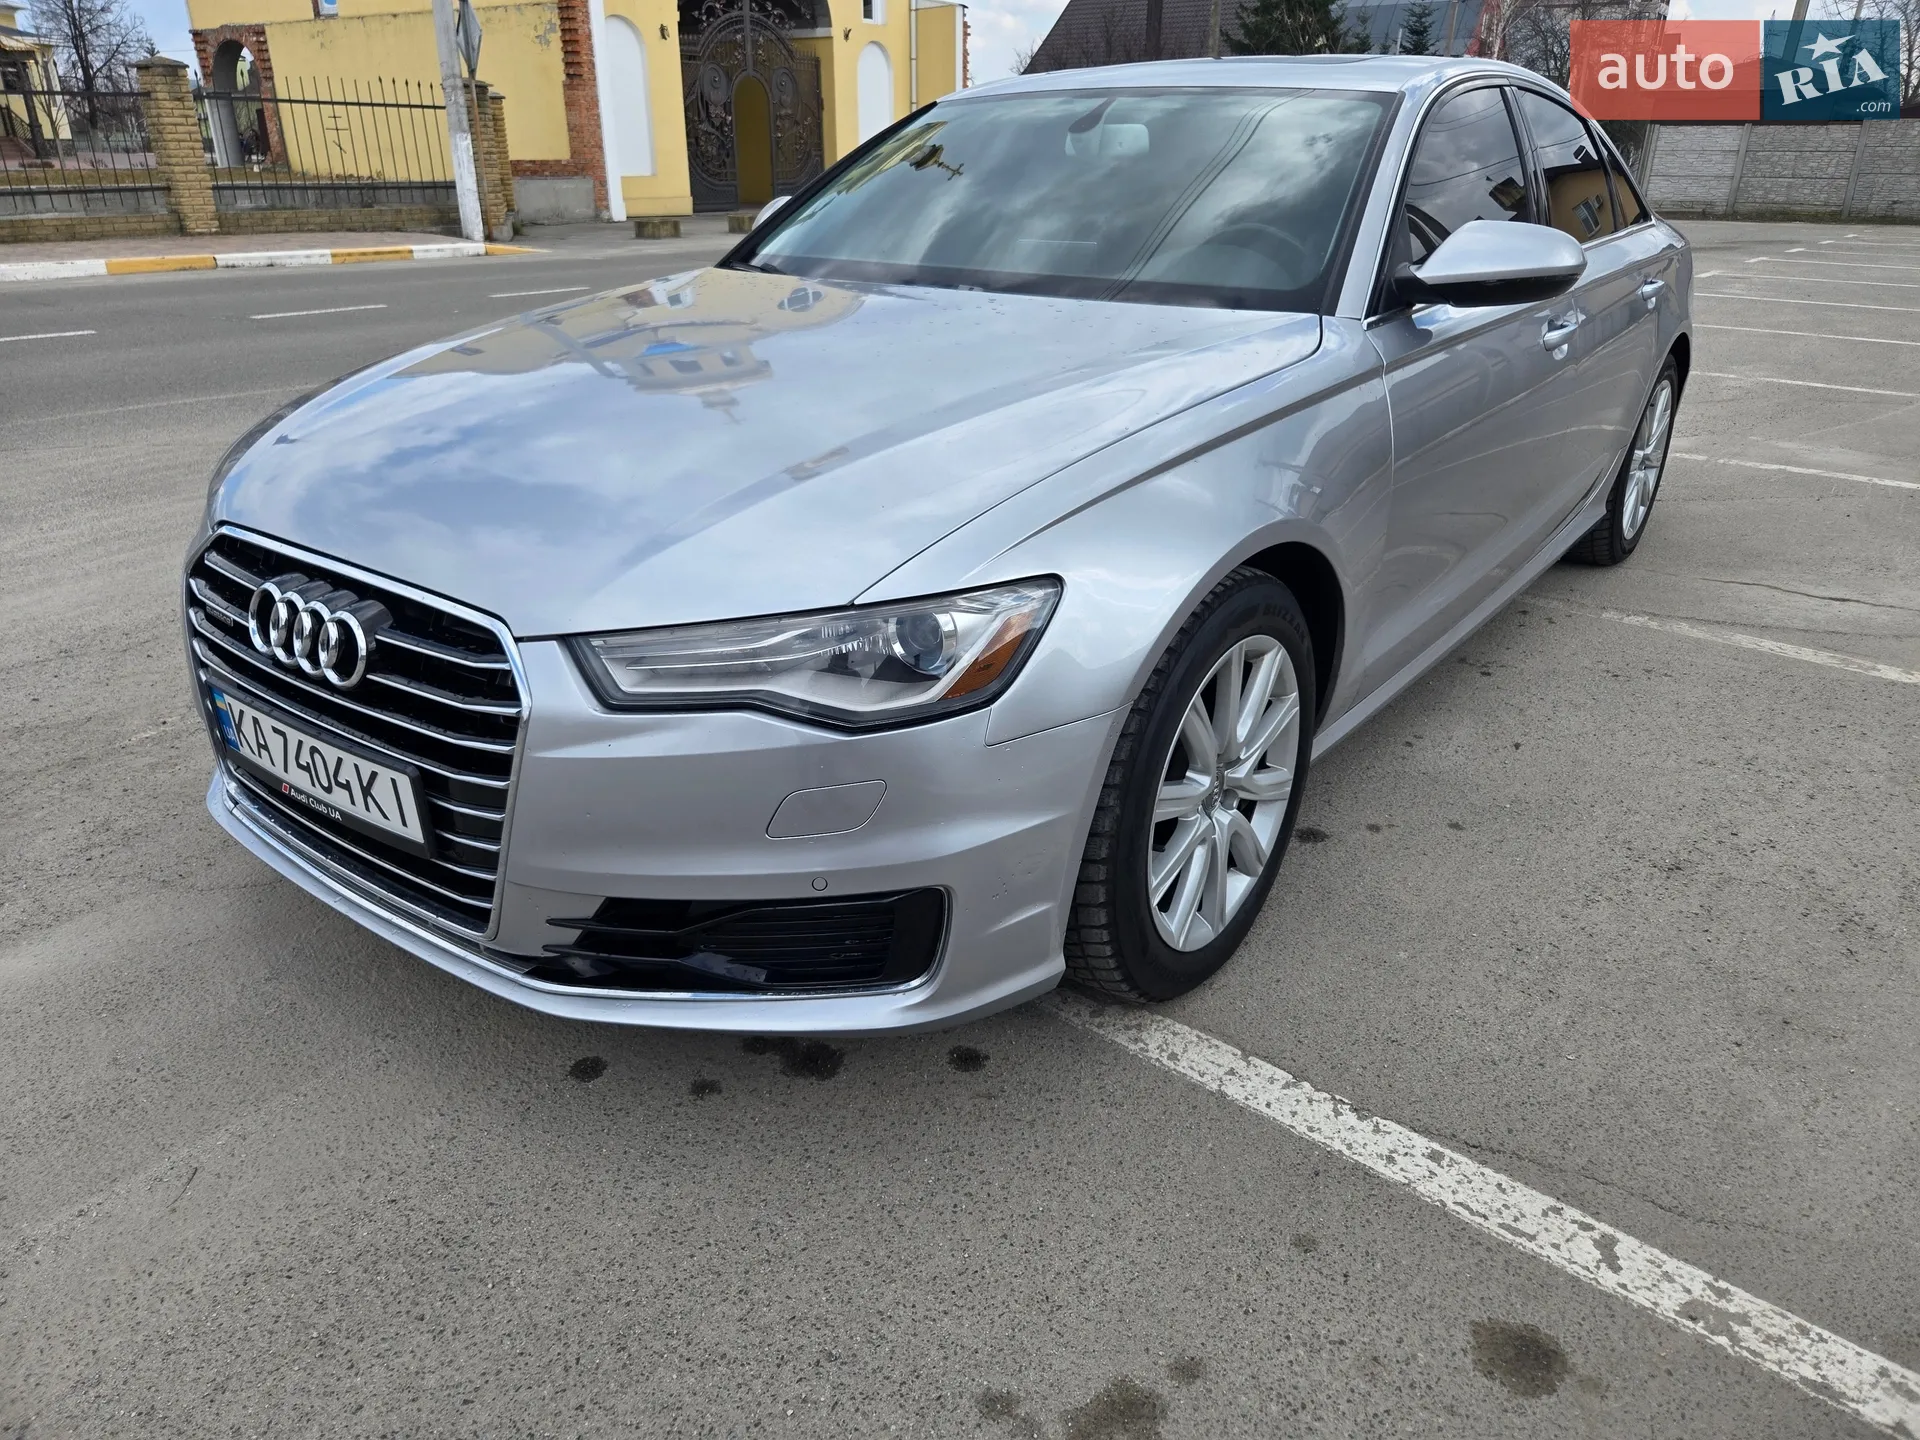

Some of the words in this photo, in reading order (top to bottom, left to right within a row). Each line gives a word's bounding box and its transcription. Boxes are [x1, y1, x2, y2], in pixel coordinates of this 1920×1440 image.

[290, 788, 308, 804] Audi
[309, 797, 328, 814] Club
[328, 807, 343, 821] UA
